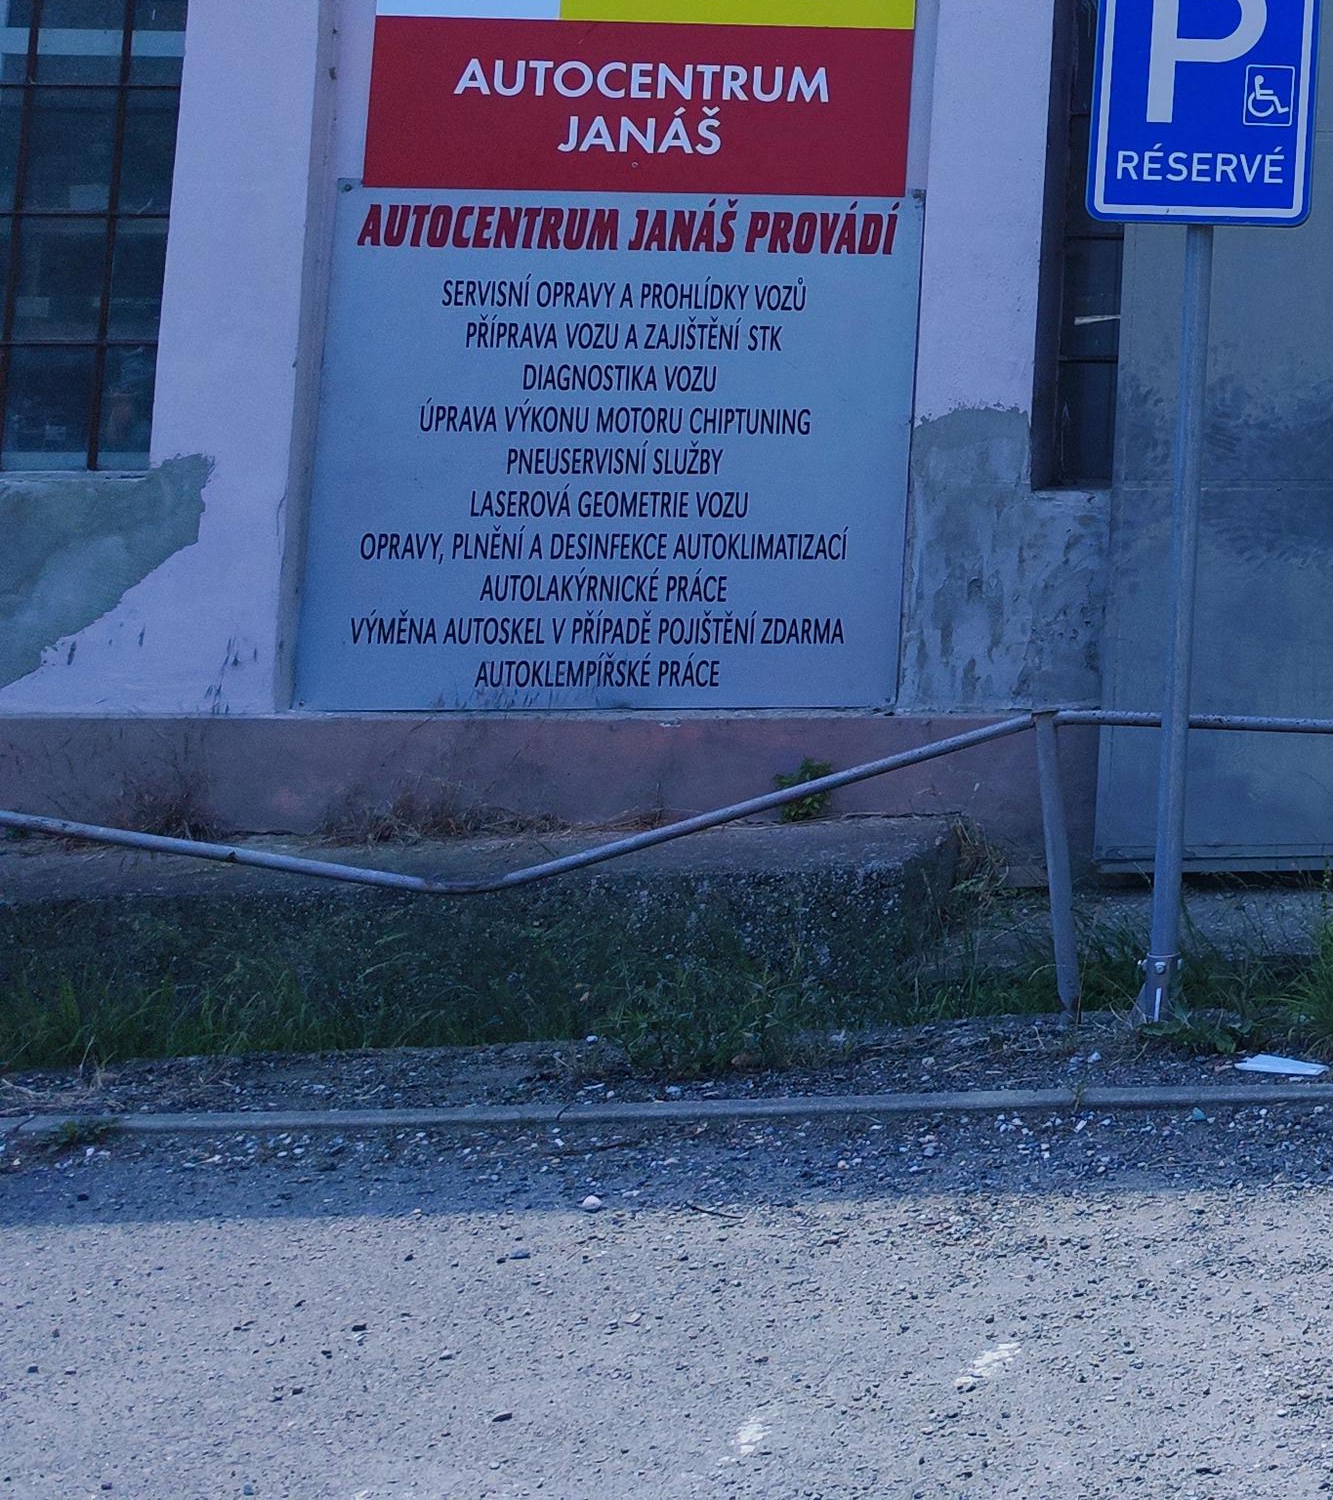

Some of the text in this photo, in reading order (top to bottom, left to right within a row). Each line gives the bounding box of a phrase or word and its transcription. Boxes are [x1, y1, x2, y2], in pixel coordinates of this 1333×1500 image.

[454, 58, 830, 103] AUTOCENTRUM
[558, 106, 723, 156] JANÁŠ
[1116, 143, 1285, 184] RÉSERVÉ
[357, 198, 900, 255] AUTOCENTRUM JANÁŠ PROVÁDÍ
[442, 274, 807, 311] SERVISNÍ OPRAVY A PROHLÍDKY VOZŮ
[465, 314, 782, 352] PŘÍPRAVA VOZU A ZAJIŠTĚNÍ STK
[523, 364, 717, 392] DIAGNOSTIKA VOZU
[420, 397, 811, 434] ÚPRAVA VÝKONU MOTORU CHIPTUNING
[507, 441, 723, 475] PNEUSERVISNÍ SLUŽBY
[470, 483, 749, 518] LASEROVÁ GEOMETRIE VOZU
[360, 525, 849, 564] OPRAVY, PLNĚNÍ A DESINFEKCE AUTOKLIMATIZACÍ
[480, 567, 727, 602] AUTOLAKÝRNICKÉ PRÁCE
[351, 609, 844, 645] VÝMĚNA AUTOSKEL V PŘÍPADĚ POJIŠTĚNÍ ZDARMA
[474, 652, 720, 687] AUTOKLEMPÍŘSKÉ PRÁCE
